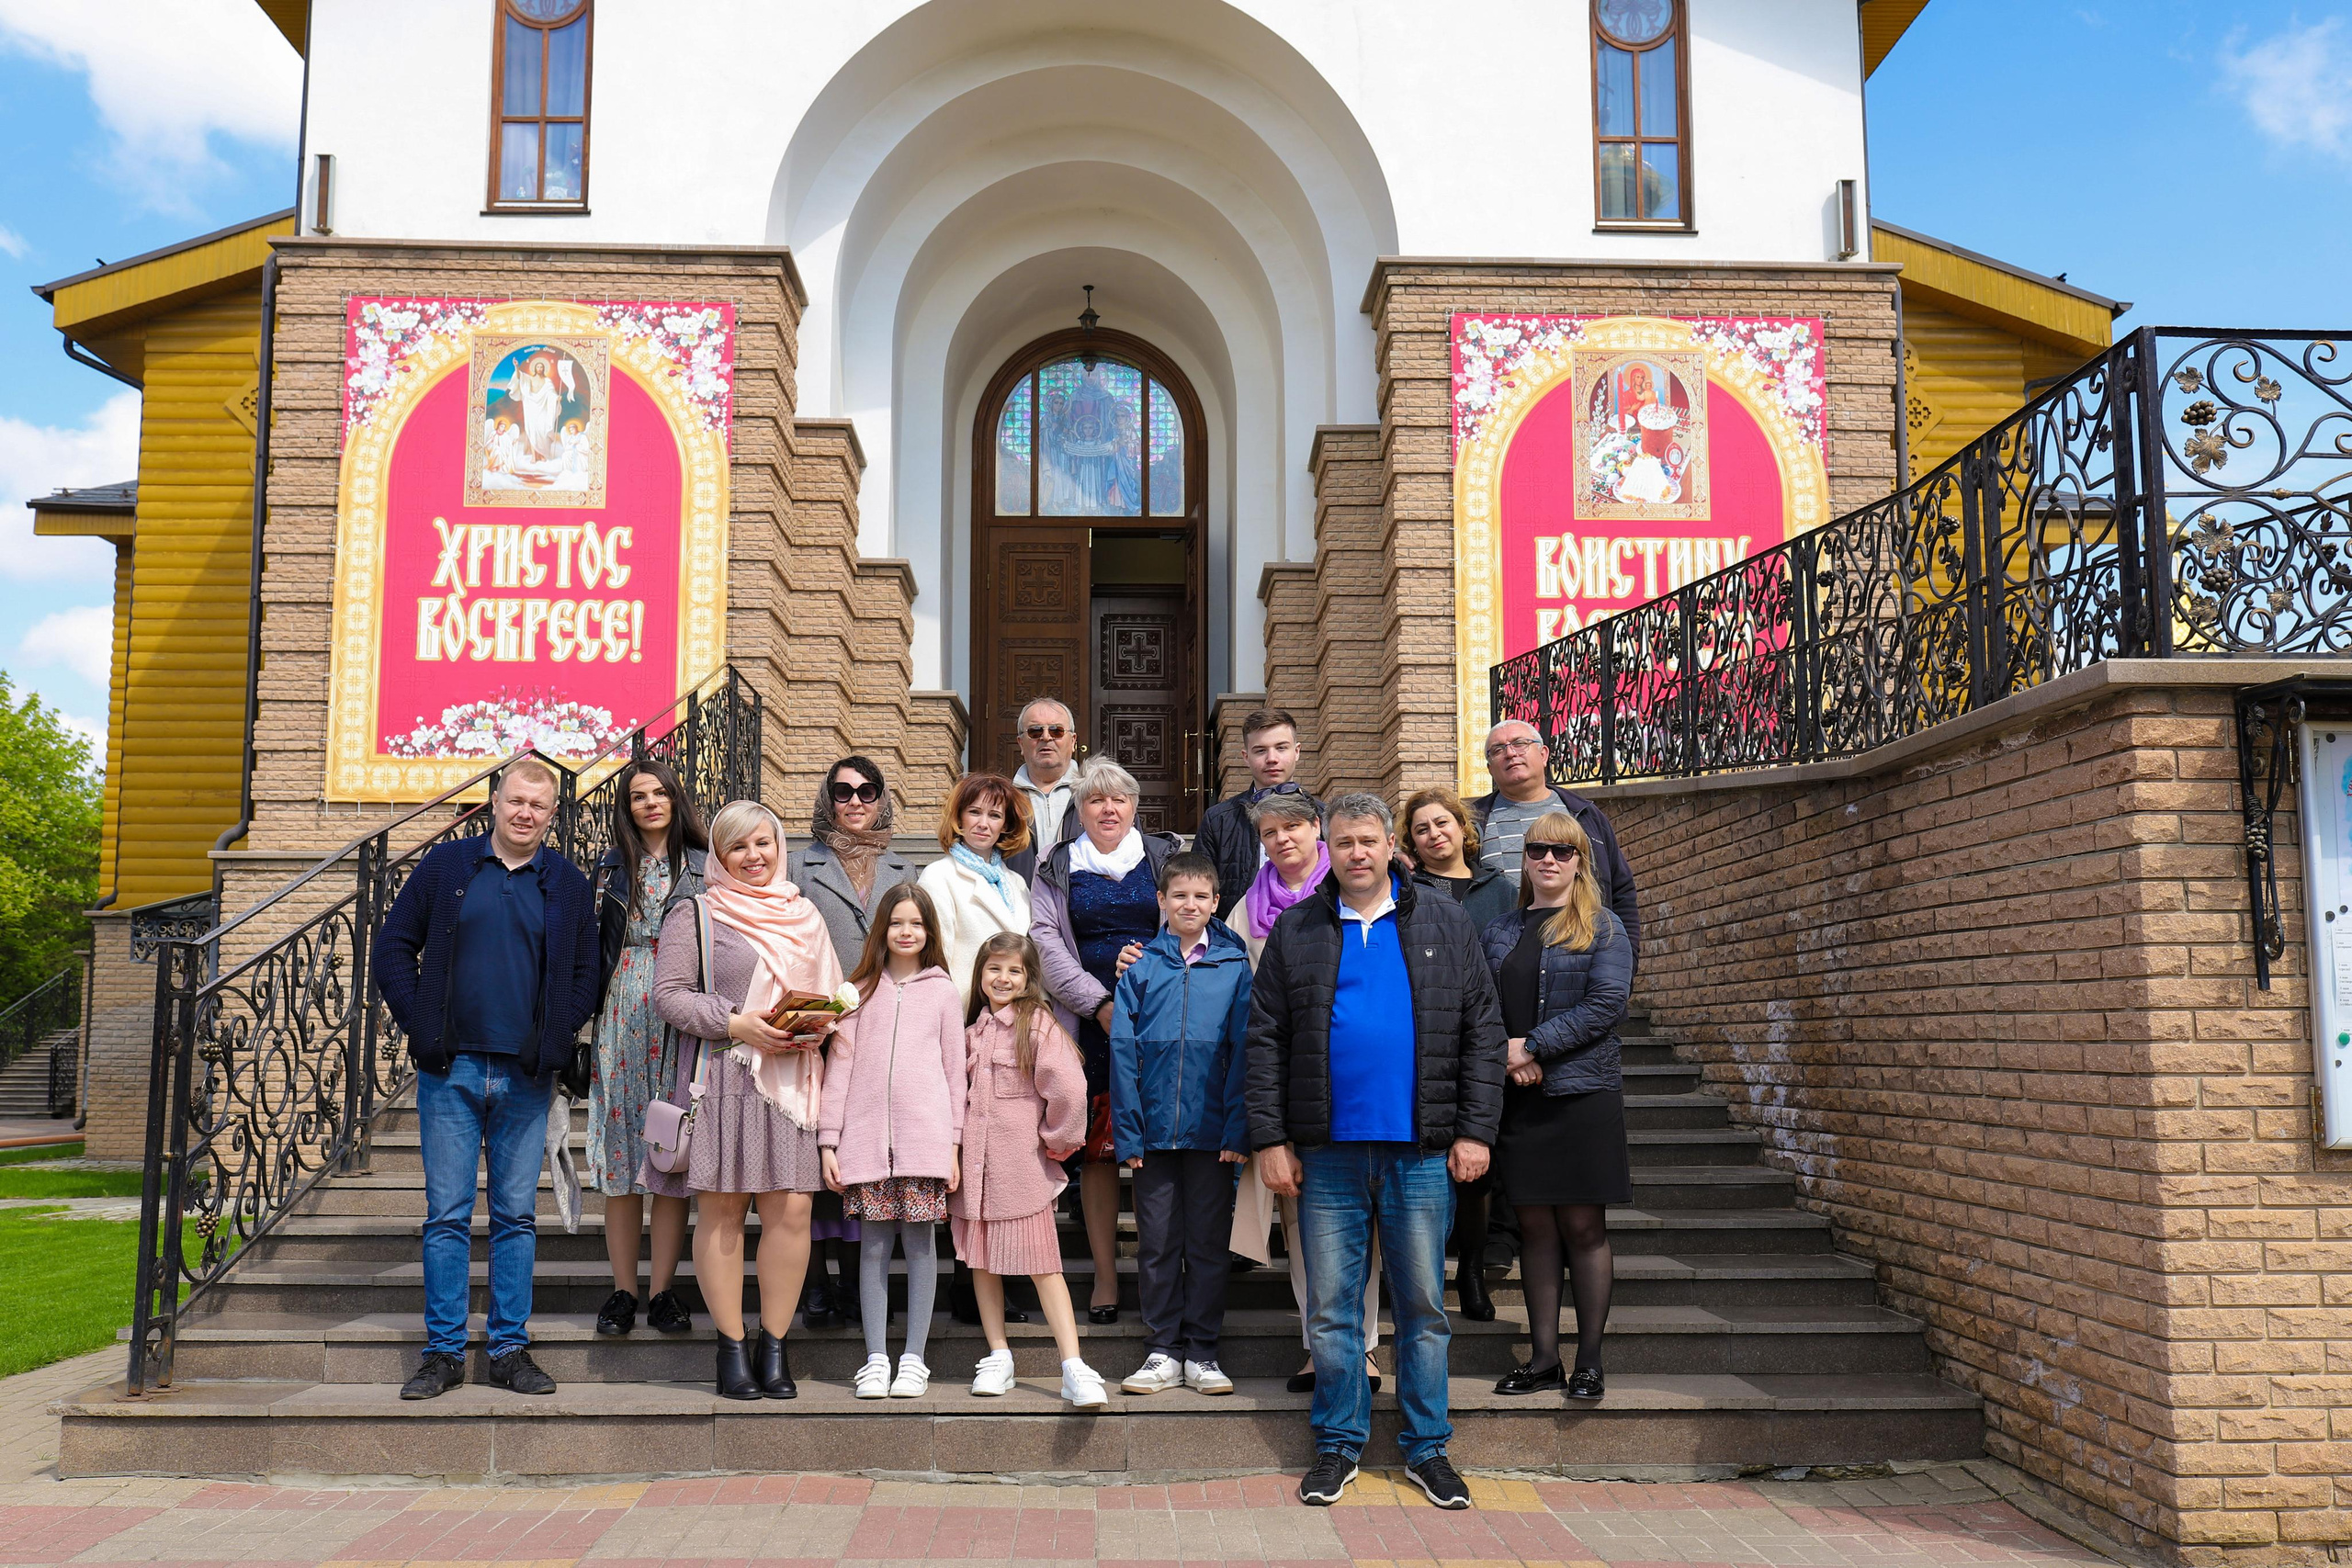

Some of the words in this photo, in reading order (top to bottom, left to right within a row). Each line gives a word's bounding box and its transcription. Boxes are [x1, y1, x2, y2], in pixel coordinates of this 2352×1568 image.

[432, 517, 633, 597] ХРИСТОС
[1534, 532, 1751, 599] ВОИСТИНУ
[415, 593, 645, 662] ВОСКРЕСЕ!
